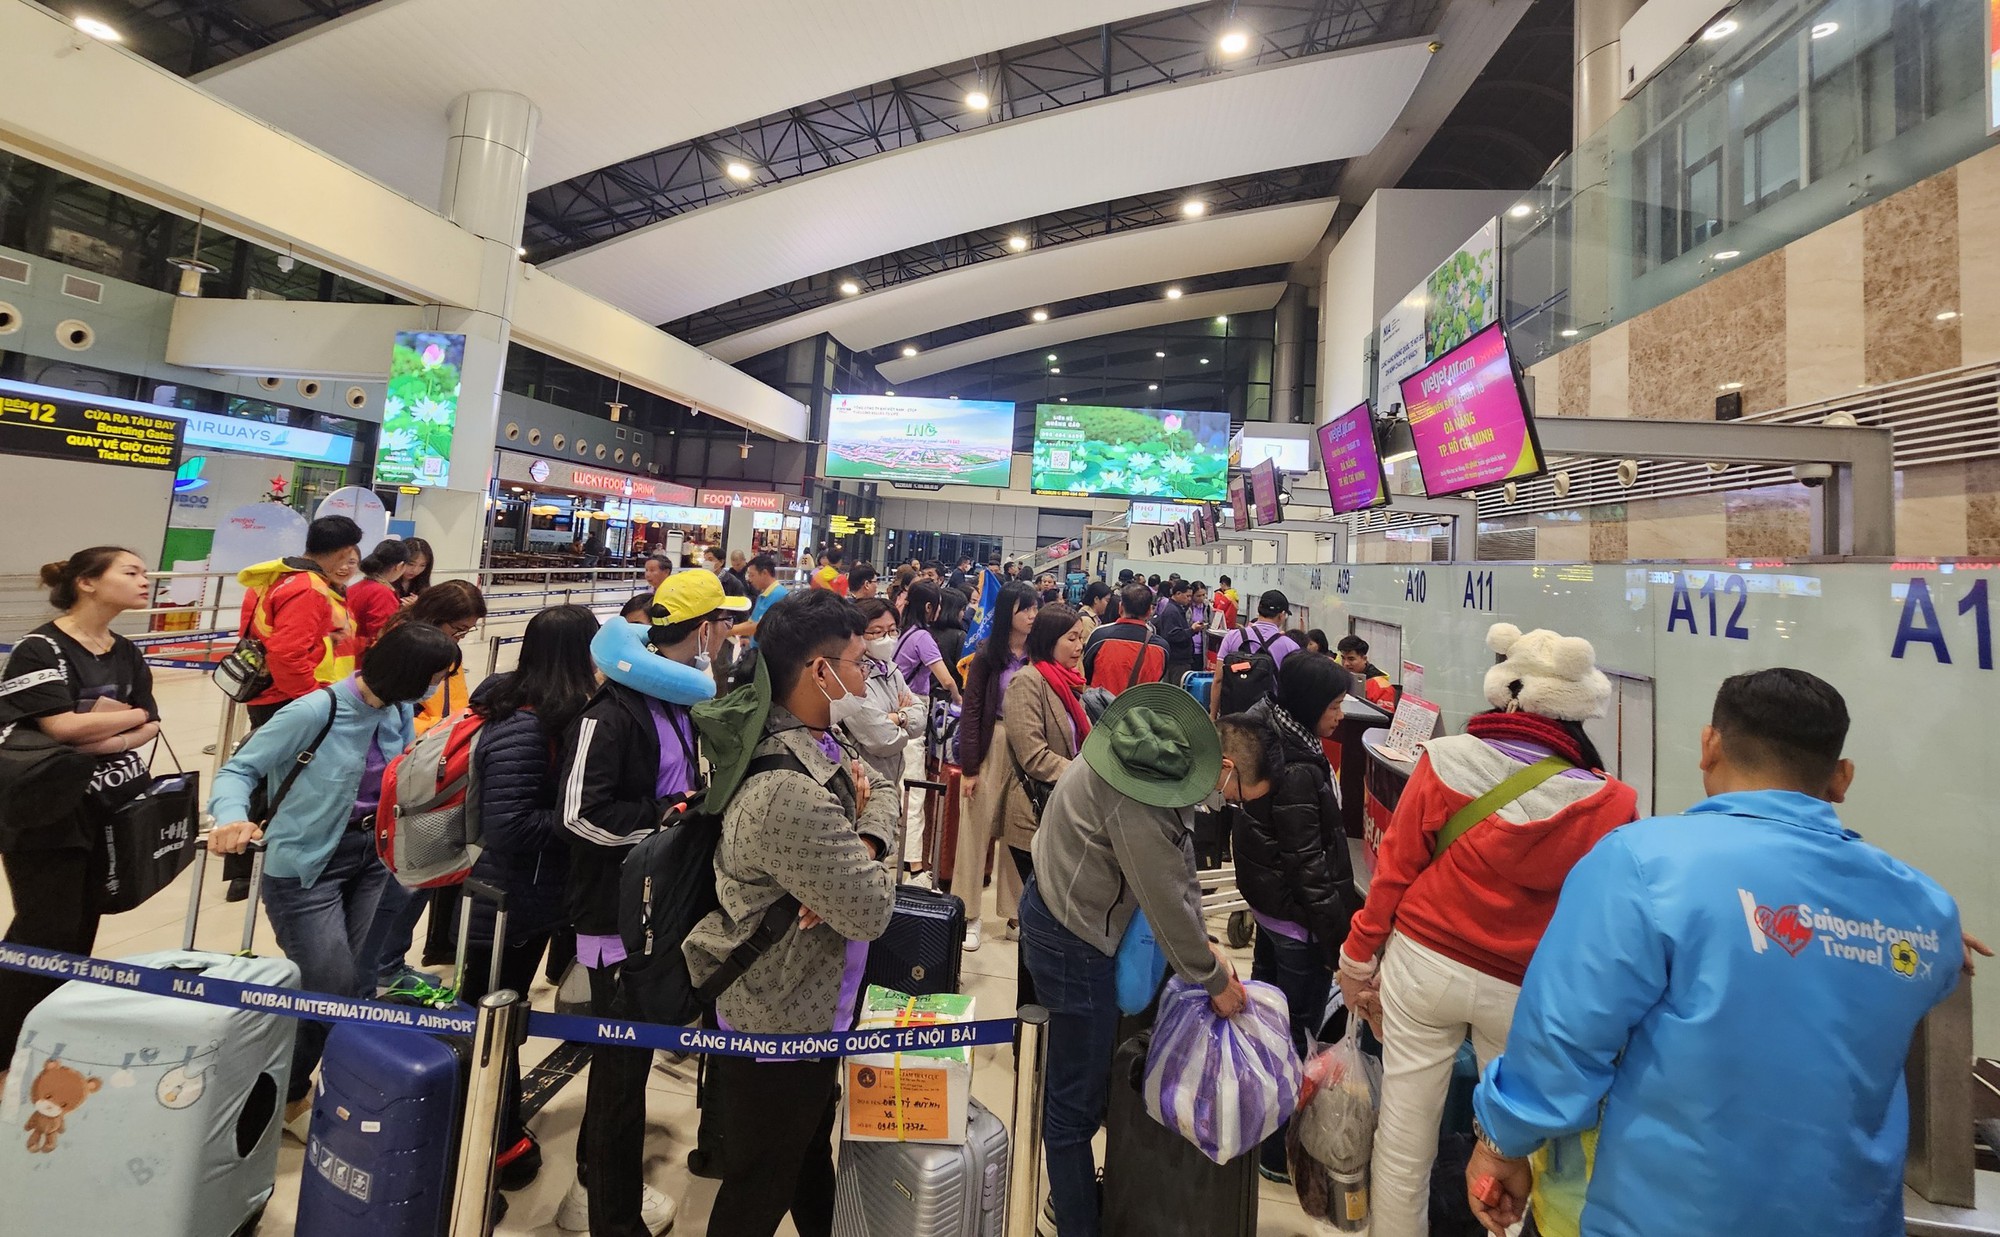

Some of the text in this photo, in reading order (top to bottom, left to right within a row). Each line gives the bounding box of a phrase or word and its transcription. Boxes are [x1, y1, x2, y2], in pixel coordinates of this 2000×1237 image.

[28, 402, 57, 424] 12
[84, 408, 176, 430] CỬA RA TÀU BAY
[96, 422, 174, 441] Boarding Gates
[186, 420, 271, 442] AIRWAYS
[66, 435, 172, 455] QUẦY VÉ GIỜ CHÓT
[98, 448, 171, 465] Ticket Counter
[573, 472, 656, 496] LUCKY FOOD DRINK
[703, 494, 732, 504] FOOD
[742, 496, 776, 507] DRINK
[1336, 569, 1350, 594] A09
[1405, 570, 1426, 604] A10
[1463, 570, 1493, 611] A11
[1667, 572, 1749, 640] A12
[1738, 888, 1939, 954] I Saigontourist
[1818, 935, 1883, 966] Travel
[28, 954, 69, 973] QUỐC
[72, 960, 89, 976] TẾ
[92, 964, 114, 984] NỘI
[116, 970, 140, 986] BÀI
[173, 979, 204, 996] N.I.A
[240, 990, 292, 1010] NOIBAI
[294, 999, 413, 1026] INTERNATIONAL
[598, 1024, 976, 1055] N.I.A CẢNG HÀNG KHÔNG QUỐC TẾ NỘI BÀI
